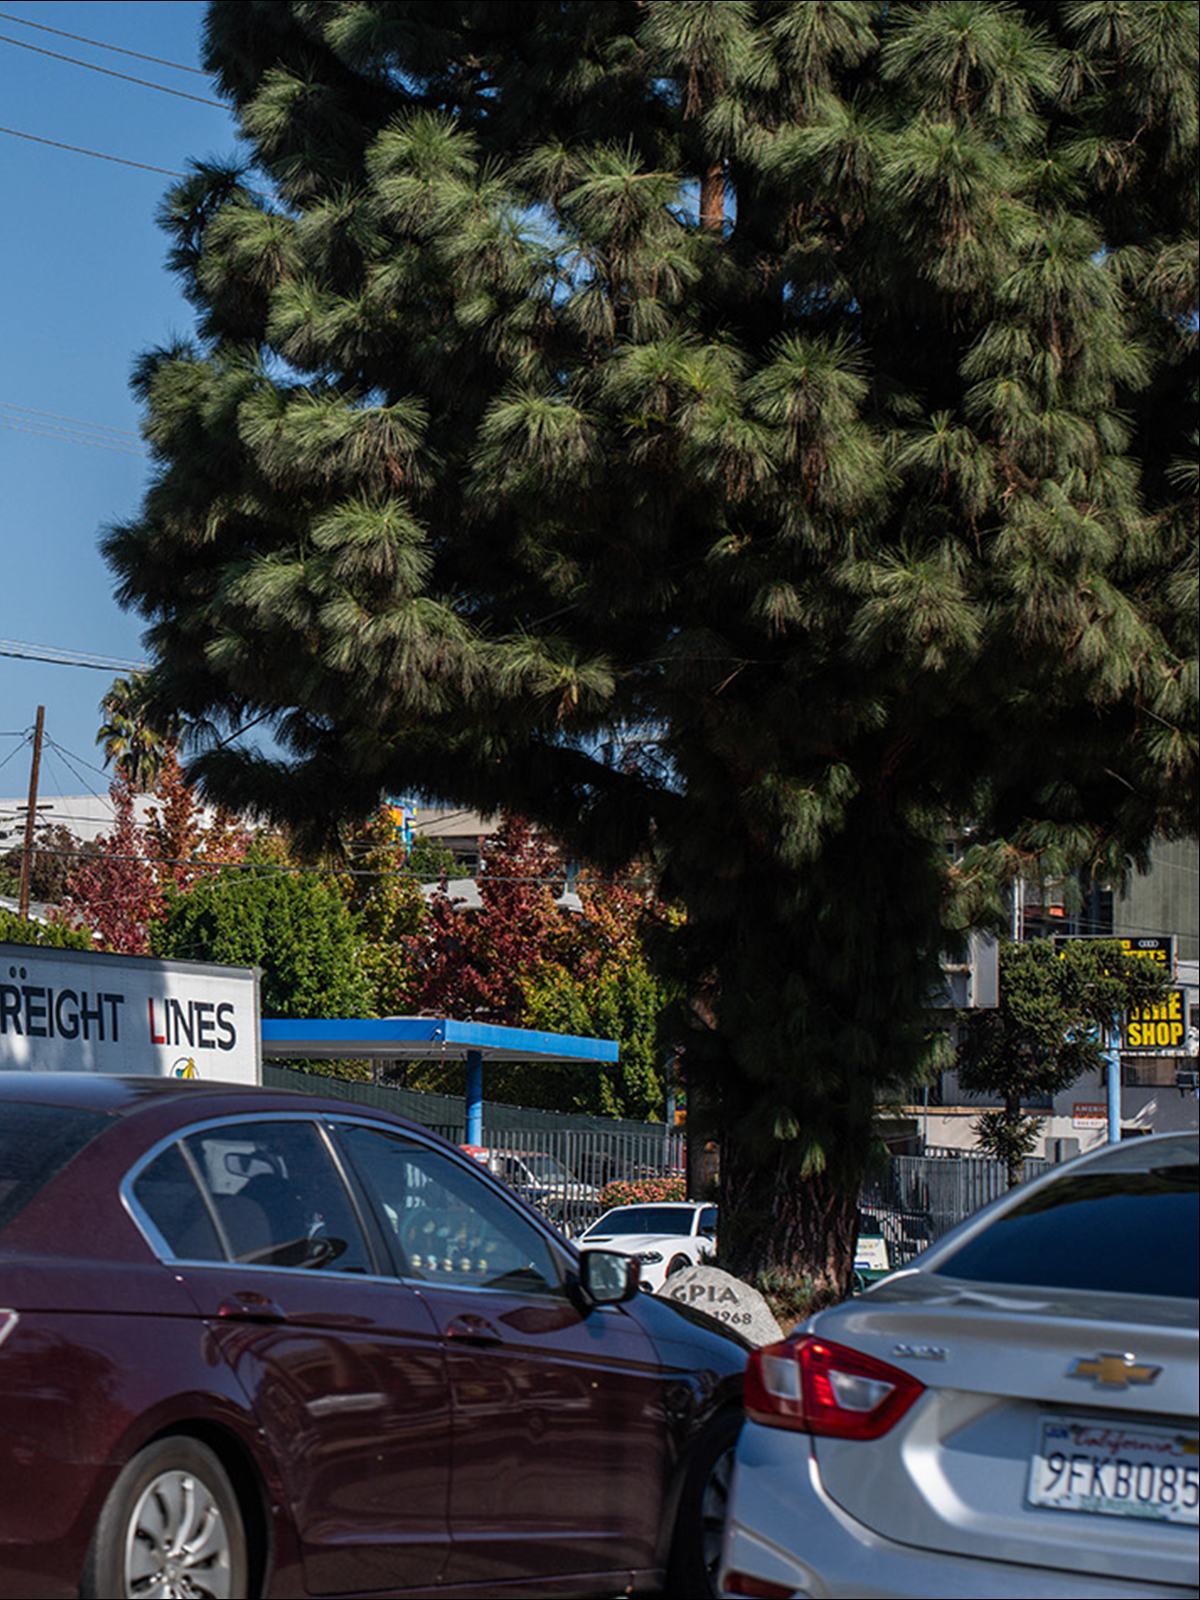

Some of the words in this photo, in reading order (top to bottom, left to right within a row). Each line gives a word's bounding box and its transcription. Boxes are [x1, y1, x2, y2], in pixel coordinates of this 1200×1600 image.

[148, 997, 237, 1051] LINES
[1128, 1022, 1183, 1046] SHOP
[1075, 1105, 1107, 1113] AMERIC
[671, 1285, 739, 1304] GPIA
[714, 1310, 752, 1325] 1968
[1073, 1428, 1184, 1456] California
[1045, 1452, 1199, 1508] 9FKB085
